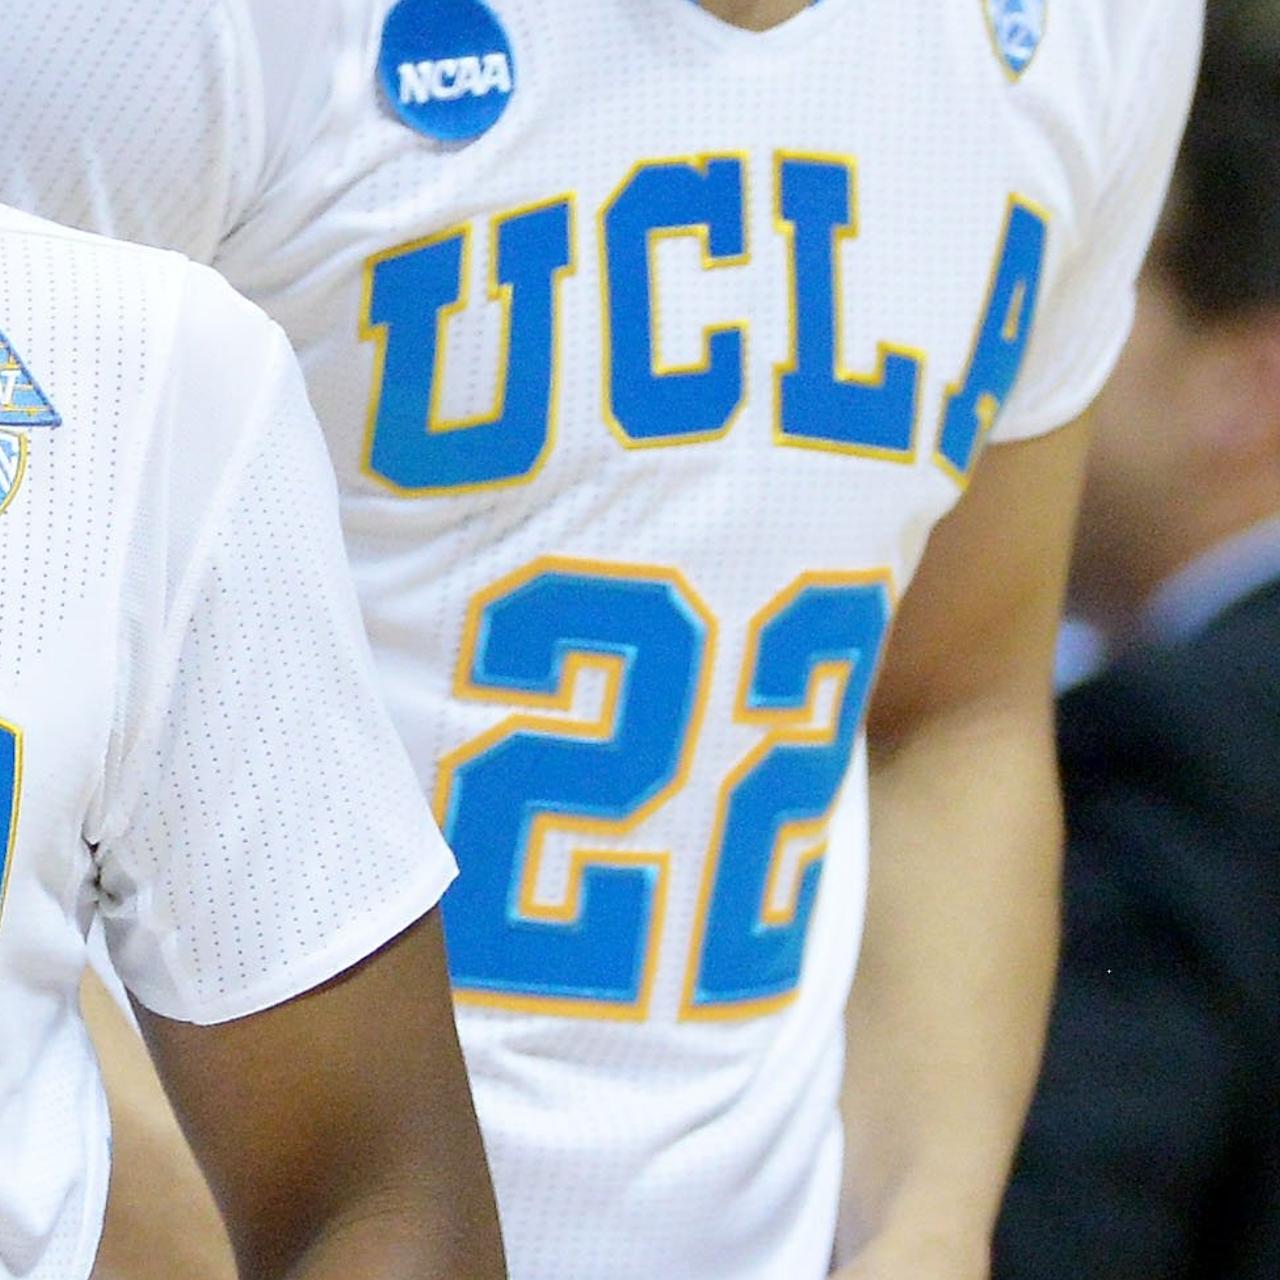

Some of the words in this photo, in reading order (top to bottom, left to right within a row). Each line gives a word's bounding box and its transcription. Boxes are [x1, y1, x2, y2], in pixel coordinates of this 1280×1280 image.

[397, 51, 512, 105] NCAA
[359, 149, 1049, 498] UCLA
[432, 554, 899, 1024] 22
